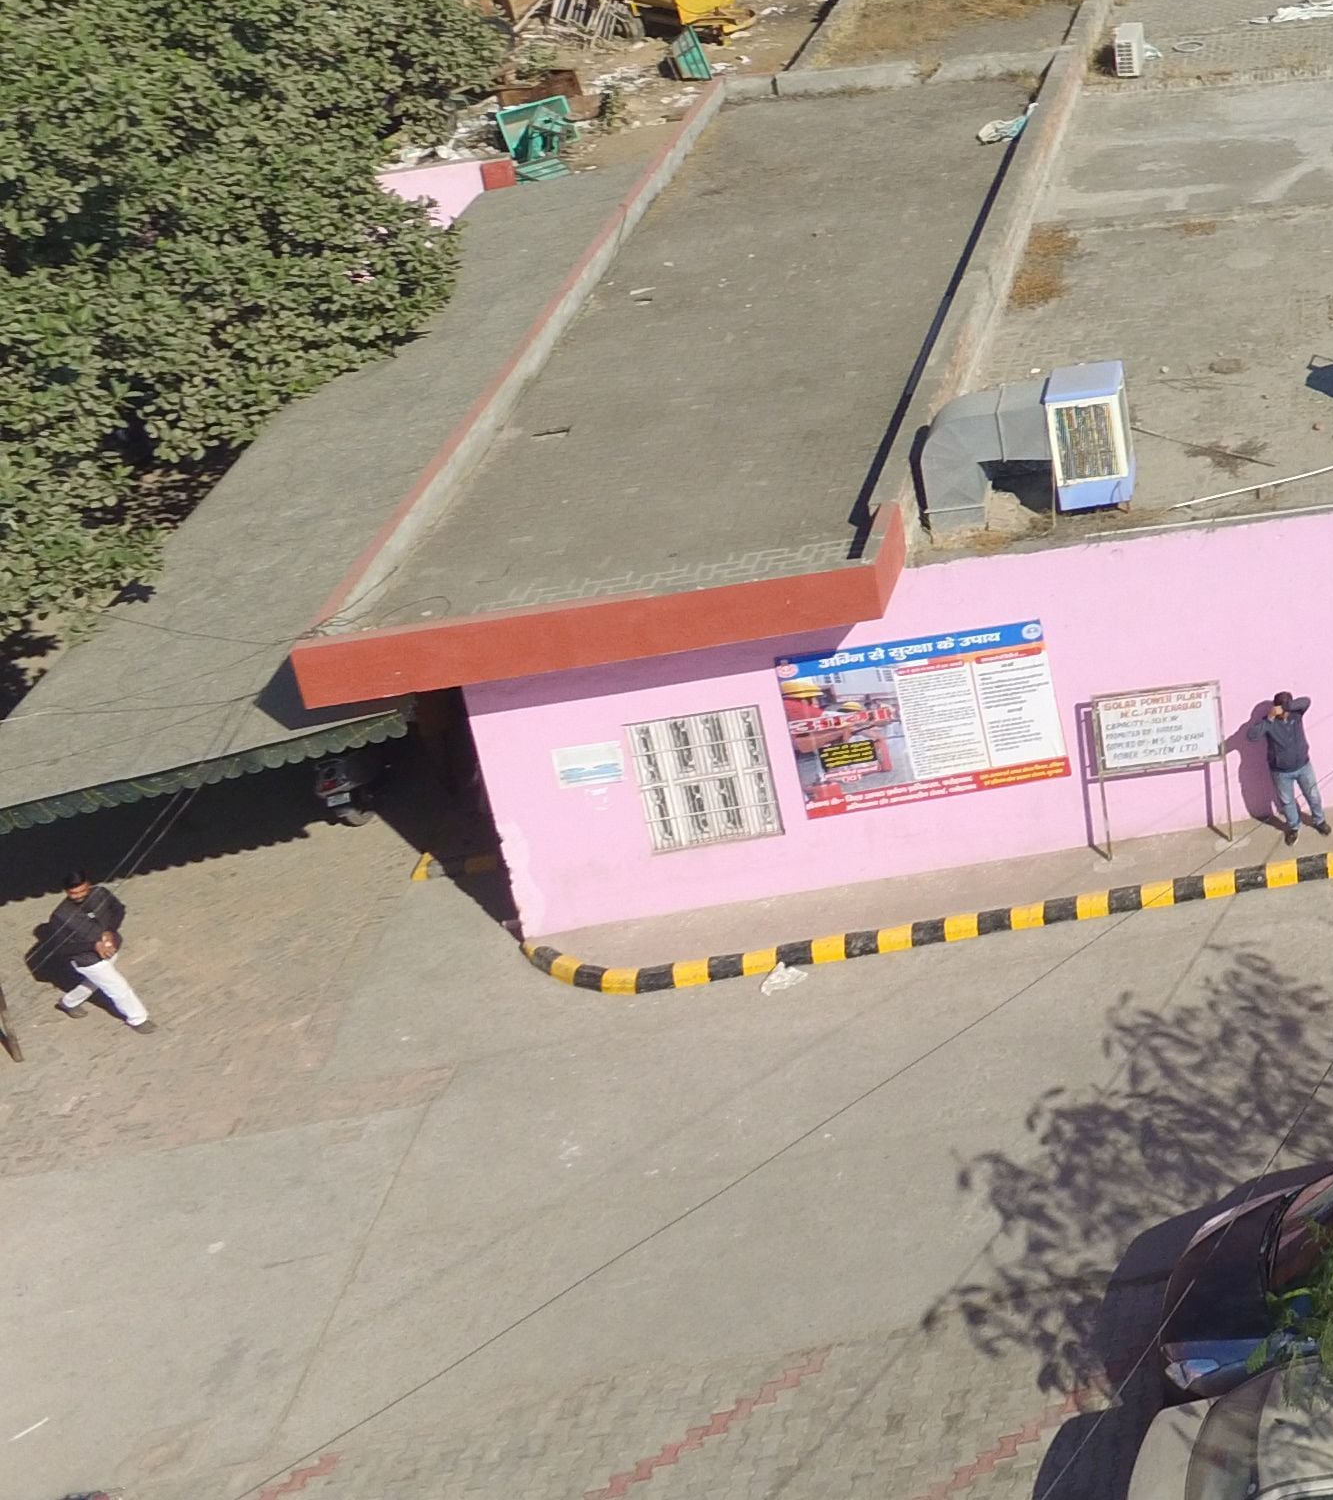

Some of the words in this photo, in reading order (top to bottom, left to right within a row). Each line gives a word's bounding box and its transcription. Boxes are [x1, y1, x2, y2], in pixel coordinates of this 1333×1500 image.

[868, 646, 885, 662] से
[936, 636, 955, 651] के
[959, 630, 1001, 648] उपाय
[1103, 700, 1136, 711] SOLAR
[1140, 694, 1172, 706] POWER
[1176, 691, 1210, 702] PLANT
[1144, 701, 1202, 716] FATEHABAD
